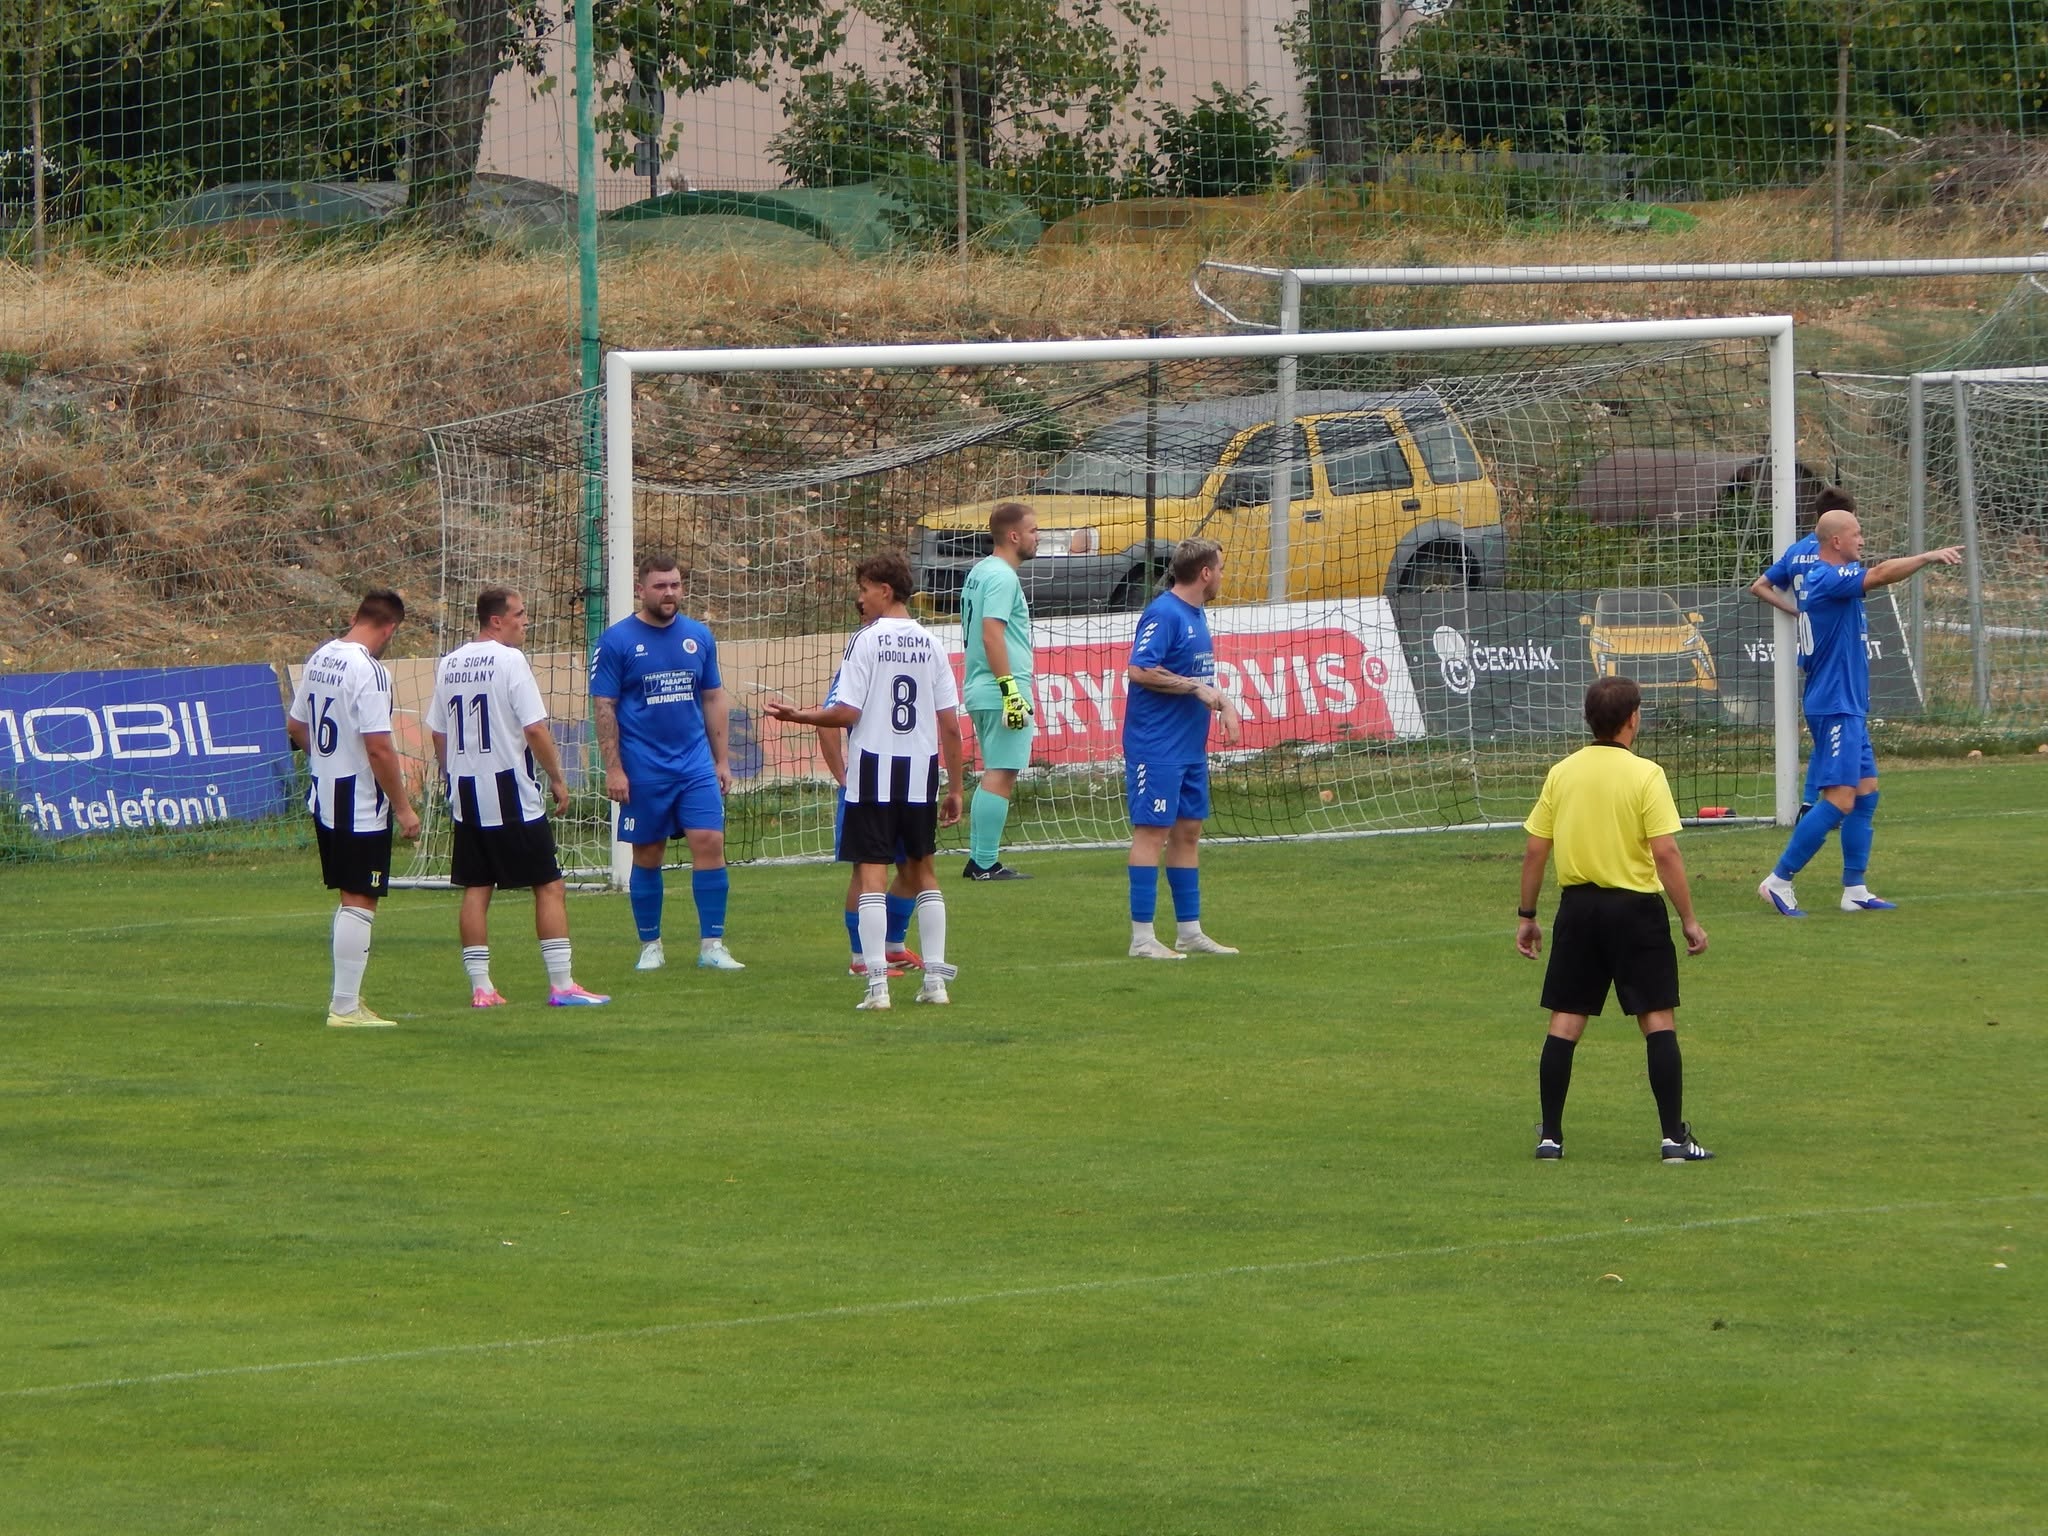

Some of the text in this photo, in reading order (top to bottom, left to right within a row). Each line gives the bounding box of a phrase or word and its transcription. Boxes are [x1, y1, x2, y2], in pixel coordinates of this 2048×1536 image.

[878, 634, 931, 649] FC SIGMA
[446, 655, 495, 670] FC SIGMA
[1470, 639, 1560, 671] ČECHÁK
[444, 669, 495, 685] HODOLANY
[891, 674, 918, 735] 8
[307, 692, 338, 758] 16
[447, 693, 492, 754] 11
[69, 784, 228, 831] telefonů
[1153, 798, 1167, 813] 24
[623, 816, 635, 832] 30
